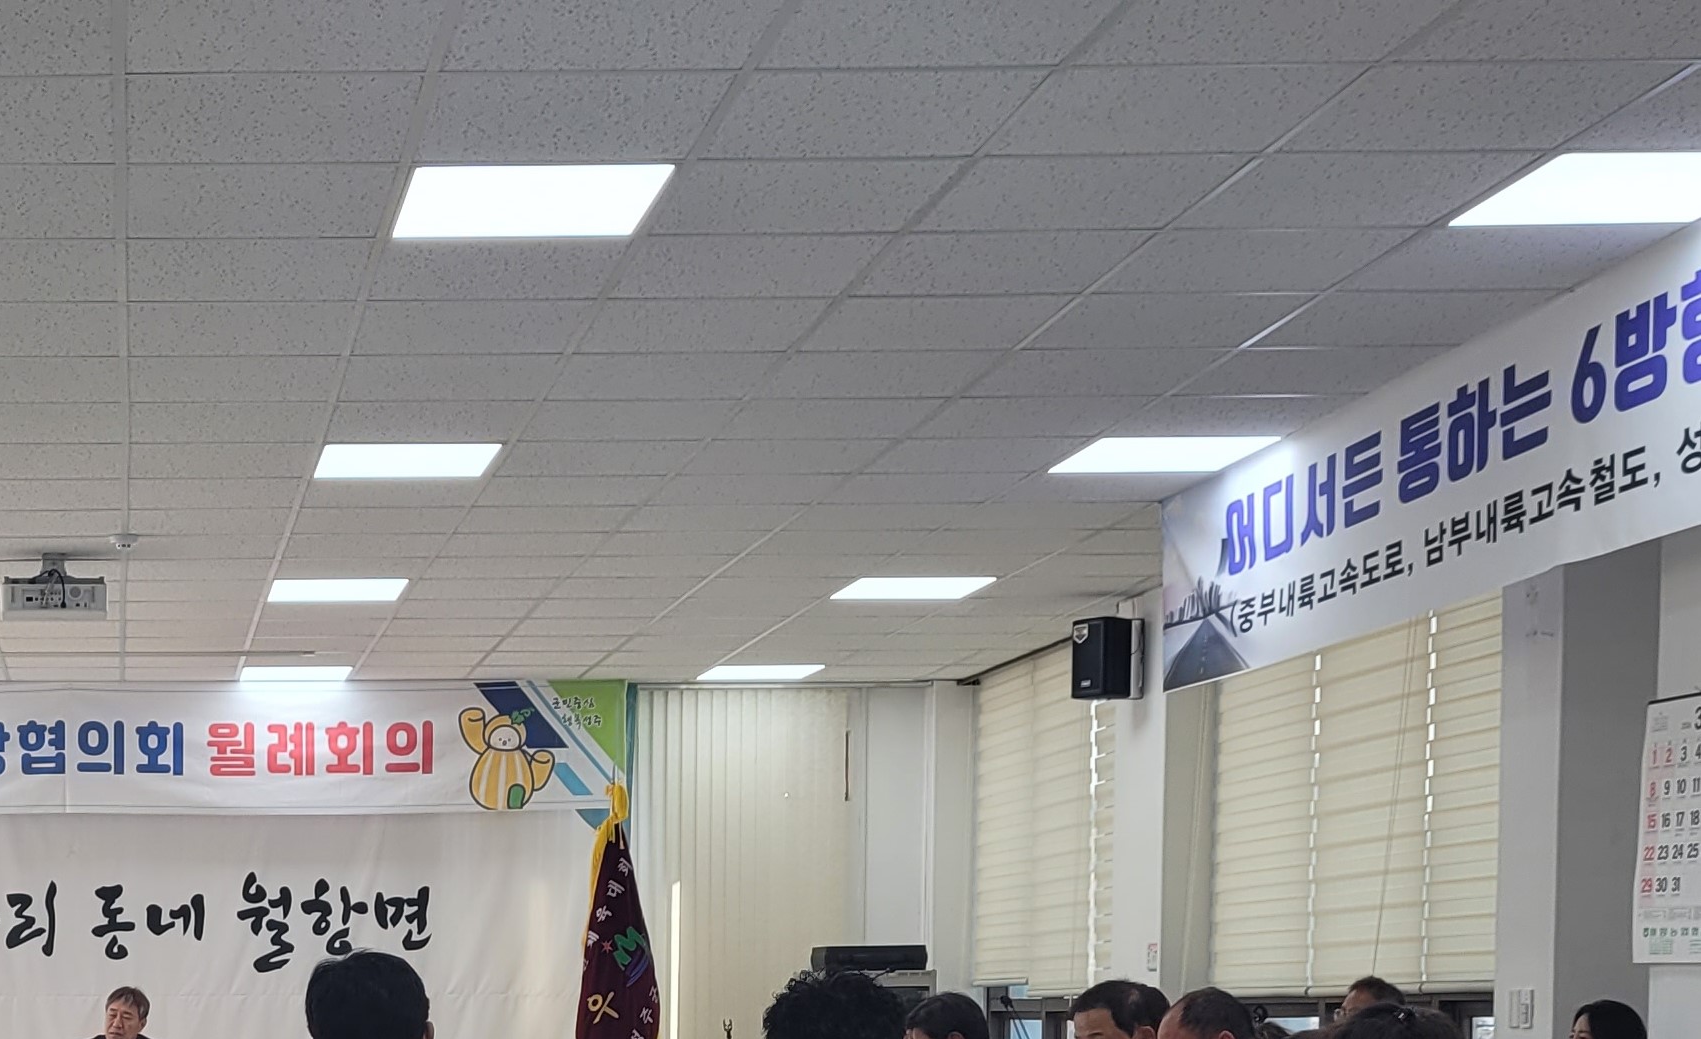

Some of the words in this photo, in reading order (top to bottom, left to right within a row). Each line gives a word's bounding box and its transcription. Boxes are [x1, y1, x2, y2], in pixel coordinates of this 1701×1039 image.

[1224, 430, 1385, 577] 어디서든
[1396, 363, 1553, 504] 통하는
[1424, 445, 1661, 568] 남부내륙고속철도,
[206, 719, 434, 777] 월례회의
[1665, 748, 1673, 763] 2
[1680, 745, 1688, 761] 3
[1663, 780, 1671, 796] 9
[1676, 778, 1687, 795] 10
[1692, 777, 1701, 793] 11
[1661, 812, 1671, 829] 16
[1675, 811, 1685, 827] 17
[1690, 809, 1700, 826] 18
[1643, 845, 1655, 861] 22
[1656, 844, 1669, 861] 23
[1671, 843, 1684, 860] 24
[1686, 842, 1700, 859] 25
[1654, 876, 1668, 893] 30
[1671, 876, 1681, 892] 31
[91, 884, 206, 960] 동네
[236, 871, 433, 974] 월항면
